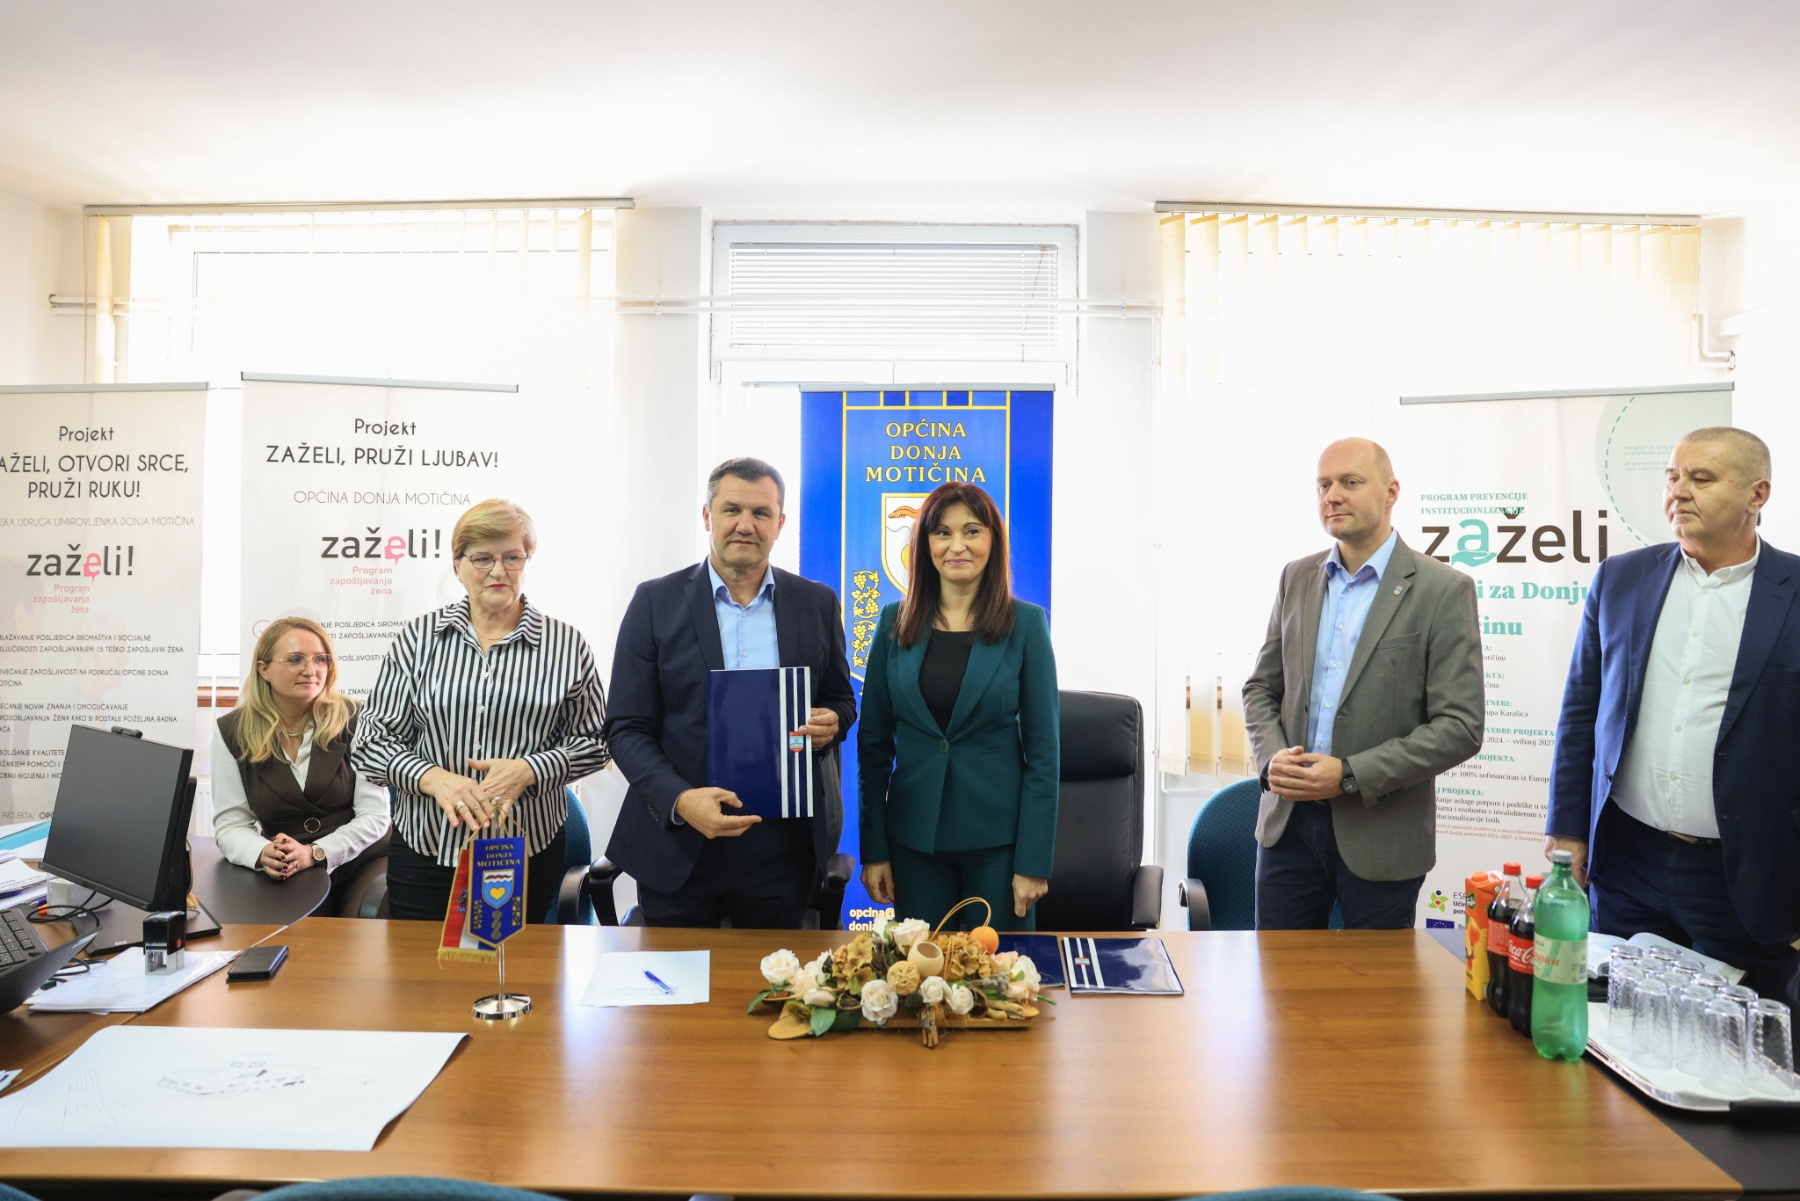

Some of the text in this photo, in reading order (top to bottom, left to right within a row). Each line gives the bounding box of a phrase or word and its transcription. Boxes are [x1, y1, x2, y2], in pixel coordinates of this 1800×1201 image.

[354, 418, 417, 436] Projekt
[885, 418, 967, 438] OPĆINA
[59, 426, 115, 443] Projekt
[266, 442, 499, 468] ZAŽELI, PRUŽI LJUBAV!
[890, 445, 962, 460] DONJA
[0, 452, 189, 475] AŽELI, OTVORI SRCE,
[865, 461, 987, 483] MOTIČINA
[28, 478, 141, 499] PRUŽI RUKU!
[293, 489, 471, 506] OPĆINA DONJA MOTIČINA
[1420, 492, 1529, 501] PROGRAM PREVENCIJE
[17, 517, 51, 527] UDRUGA
[120, 516, 150, 527] DONJA
[151, 515, 195, 527] MOTIČINA
[1421, 506, 1609, 568] zaželi
[320, 526, 441, 566] zaželi!
[26, 543, 134, 584] zaželi!
[352, 566, 393, 577] Program
[329, 576, 393, 587] zapošljavanja
[53, 584, 90, 594] Program
[371, 586, 393, 596] žena
[1489, 585, 1516, 600] za
[32, 594, 90, 606] zapošljavanja
[70, 605, 90, 614] žena
[334, 620, 376, 629] POSLJEDICA
[76, 633, 112, 641] SIROMAŠTVA
[117, 634, 152, 642] SOCIJALNE
[39, 645, 94, 653] ZAPOŠLJAVANJEM
[105, 645, 125, 653] TEŠKO
[167, 645, 184, 653] ŽENA
[337, 654, 380, 662] POŠLJIVOSTI
[29, 667, 78, 676] ZAPOŠLJIVOSTI
[52, 713, 70, 722] ŽENA
[71, 714, 87, 722] KAKO
[94, 714, 122, 722] POSTALE
[123, 714, 155, 723] POŽELJNA
[156, 715, 178, 723] RADNA
[1500, 709, 1529, 717] Karašica
[32, 749, 66, 757] KVALITETE
[1459, 770, 1478, 778] 100%
[1478, 772, 1520, 781] sufinanciran
[1441, 786, 1485, 796] PROJEKTA:
[1475, 799, 1501, 808] potpore
